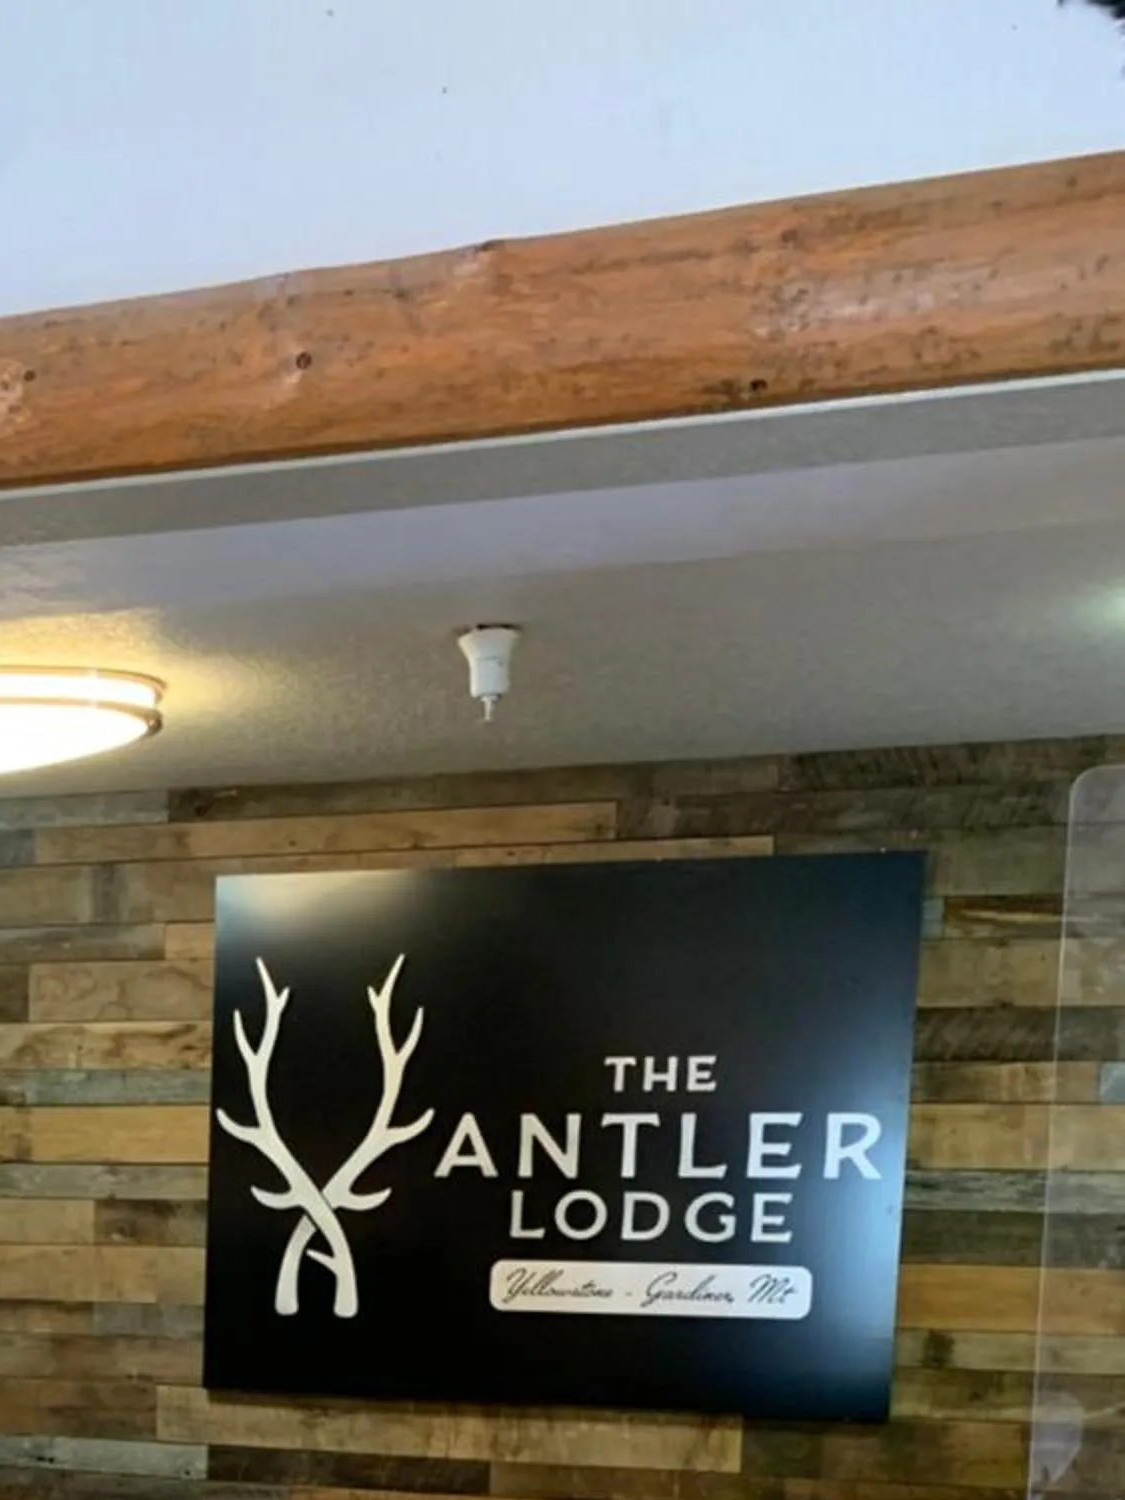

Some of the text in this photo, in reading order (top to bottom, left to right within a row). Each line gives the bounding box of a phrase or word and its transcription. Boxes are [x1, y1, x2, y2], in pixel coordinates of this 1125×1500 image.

[604, 1055, 717, 1093] THE
[433, 1111, 883, 1180] ANTLER
[509, 1190, 794, 1243] LODGE
[501, 1266, 614, 1304] Yellowstone
